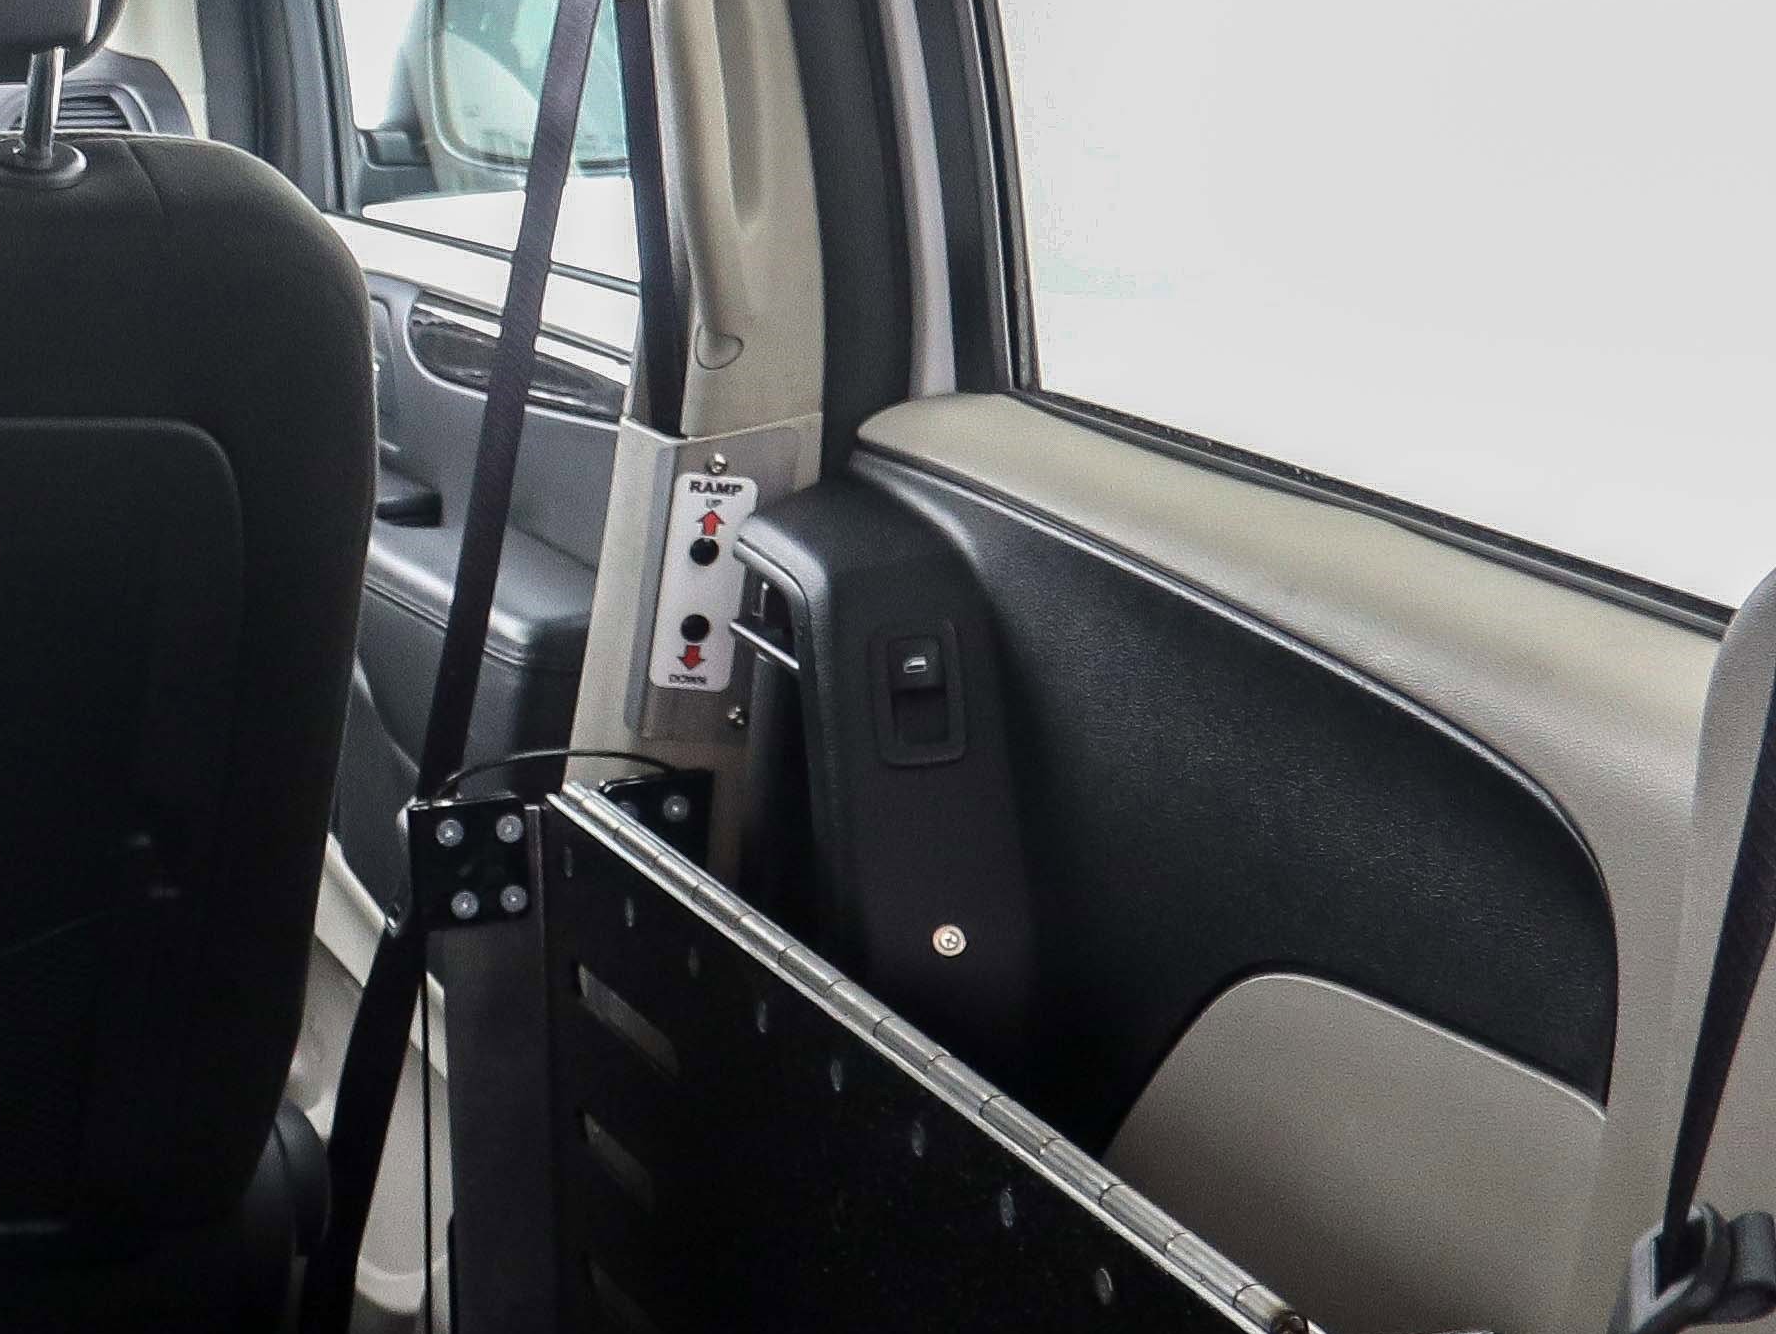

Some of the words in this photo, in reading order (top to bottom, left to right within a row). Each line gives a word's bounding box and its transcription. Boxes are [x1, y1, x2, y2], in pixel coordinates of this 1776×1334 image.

[688, 480, 744, 496] RAMP
[705, 498, 723, 509] UP
[668, 673, 708, 685] DOWN
